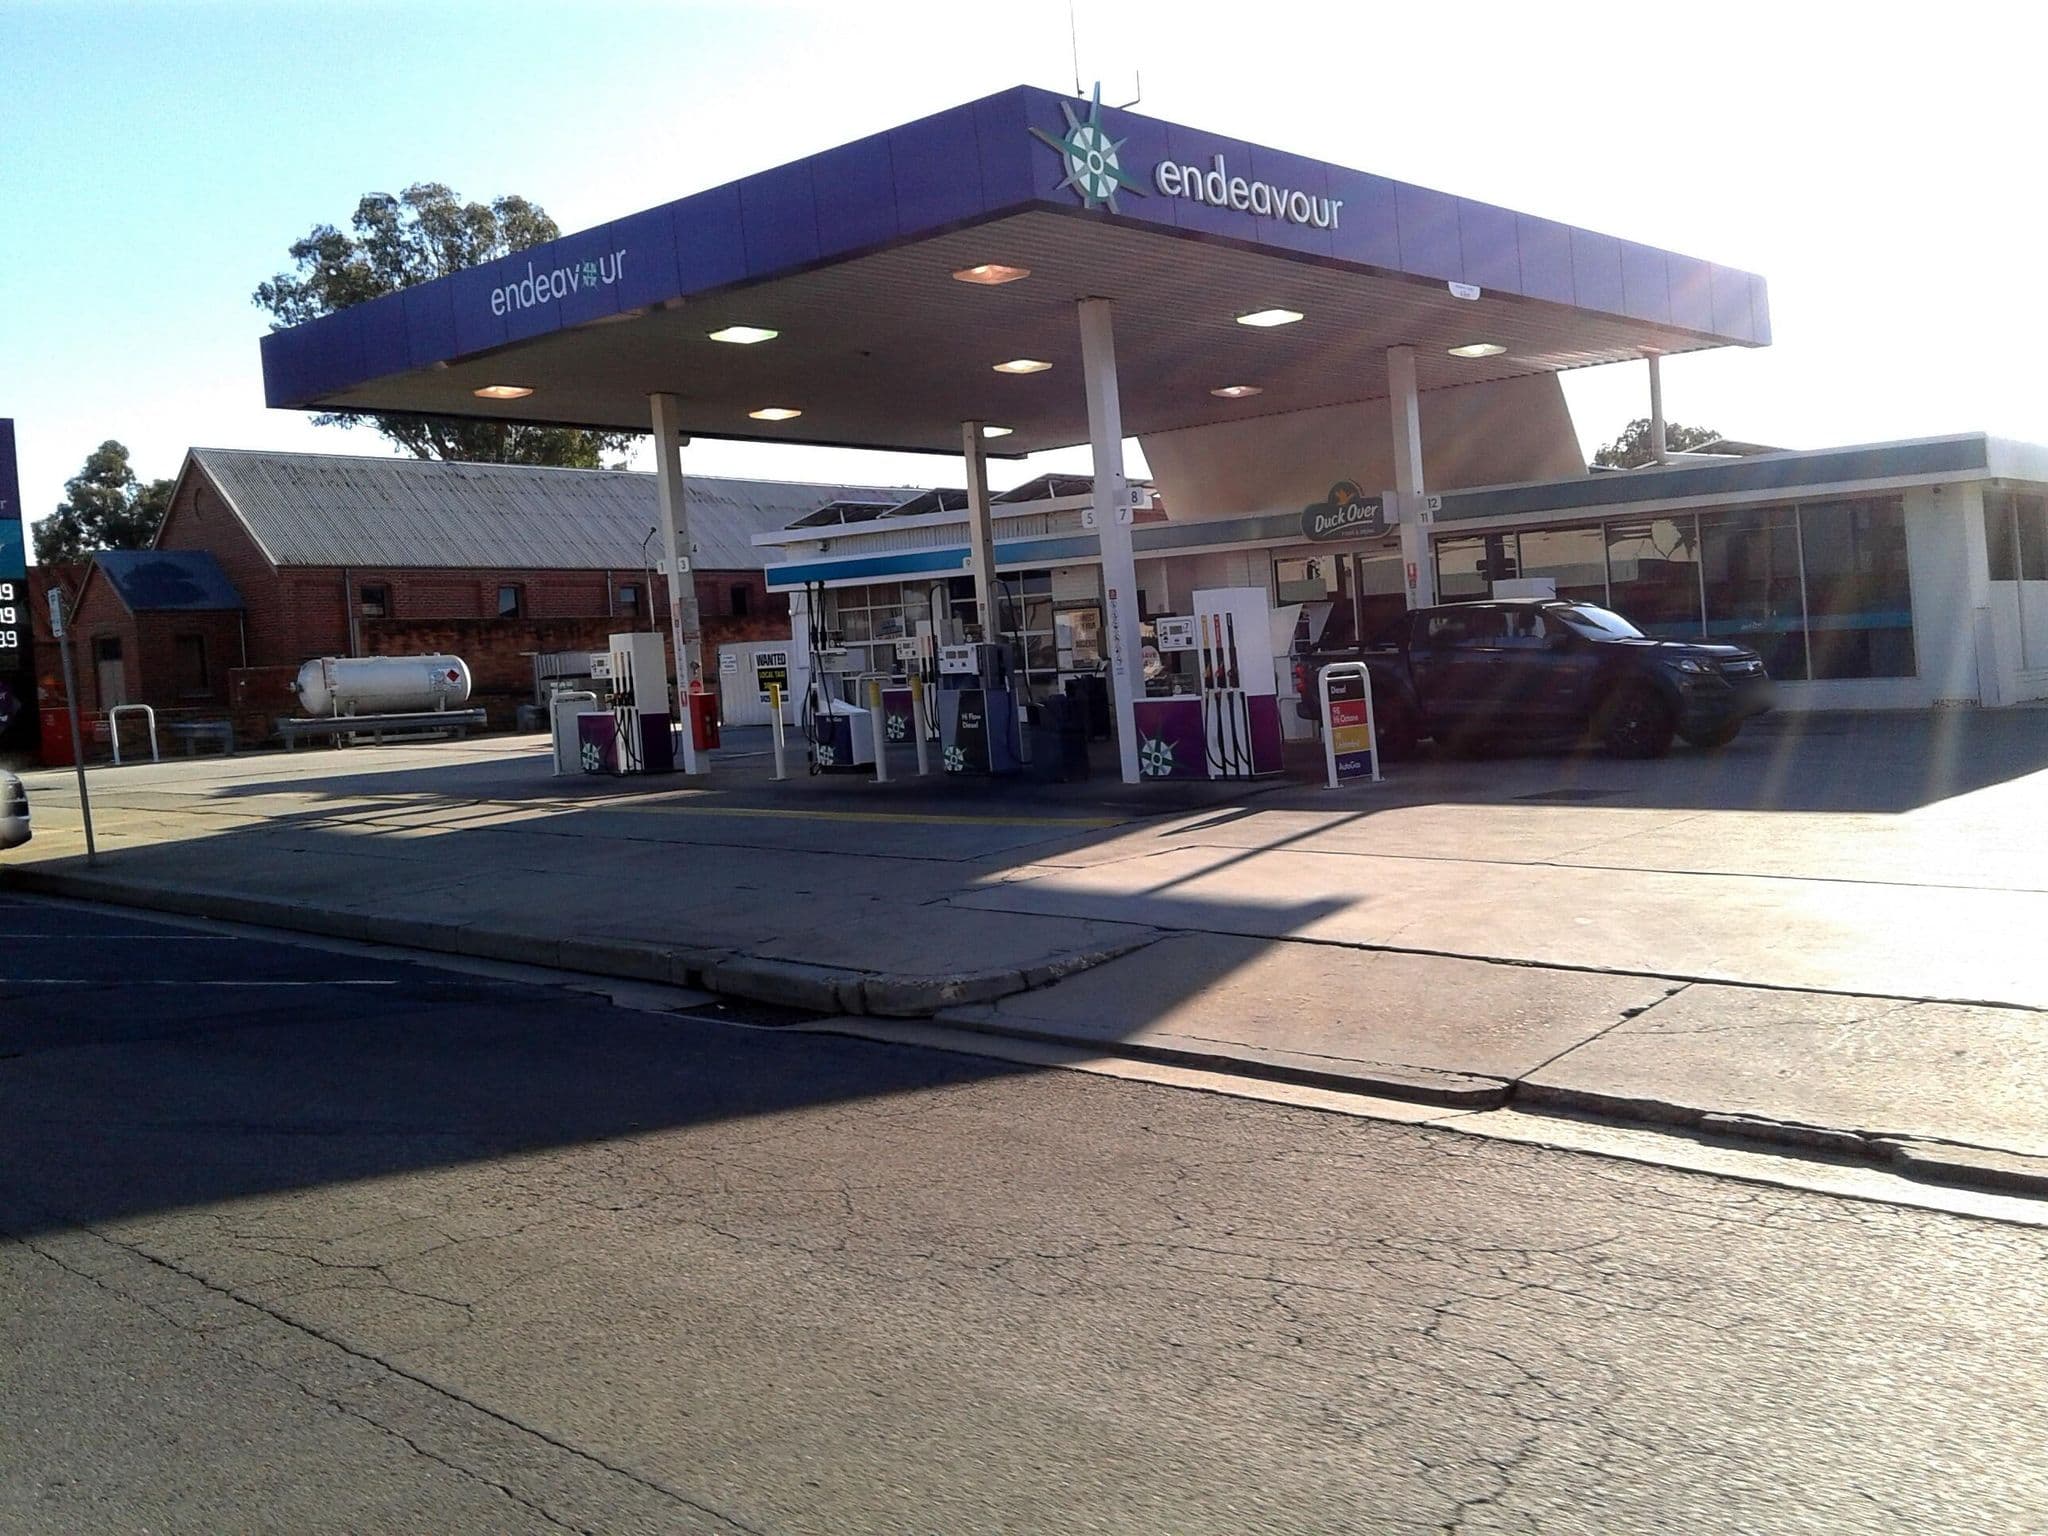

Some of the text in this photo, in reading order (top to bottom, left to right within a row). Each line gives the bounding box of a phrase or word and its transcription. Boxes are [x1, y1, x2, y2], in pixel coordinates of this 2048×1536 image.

[1154, 153, 1344, 230] endeavour
[1131, 491, 1138, 503] 8
[1427, 498, 1438, 509] 12
[1087, 513, 1093, 524] 5
[1120, 508, 1127, 520] 7
[1315, 503, 1379, 533] Duck Over
[1420, 512, 1429, 523] 11
[680, 560, 686, 570] 3
[756, 653, 786, 667] WANTED
[962, 721, 979, 729] Diesel
